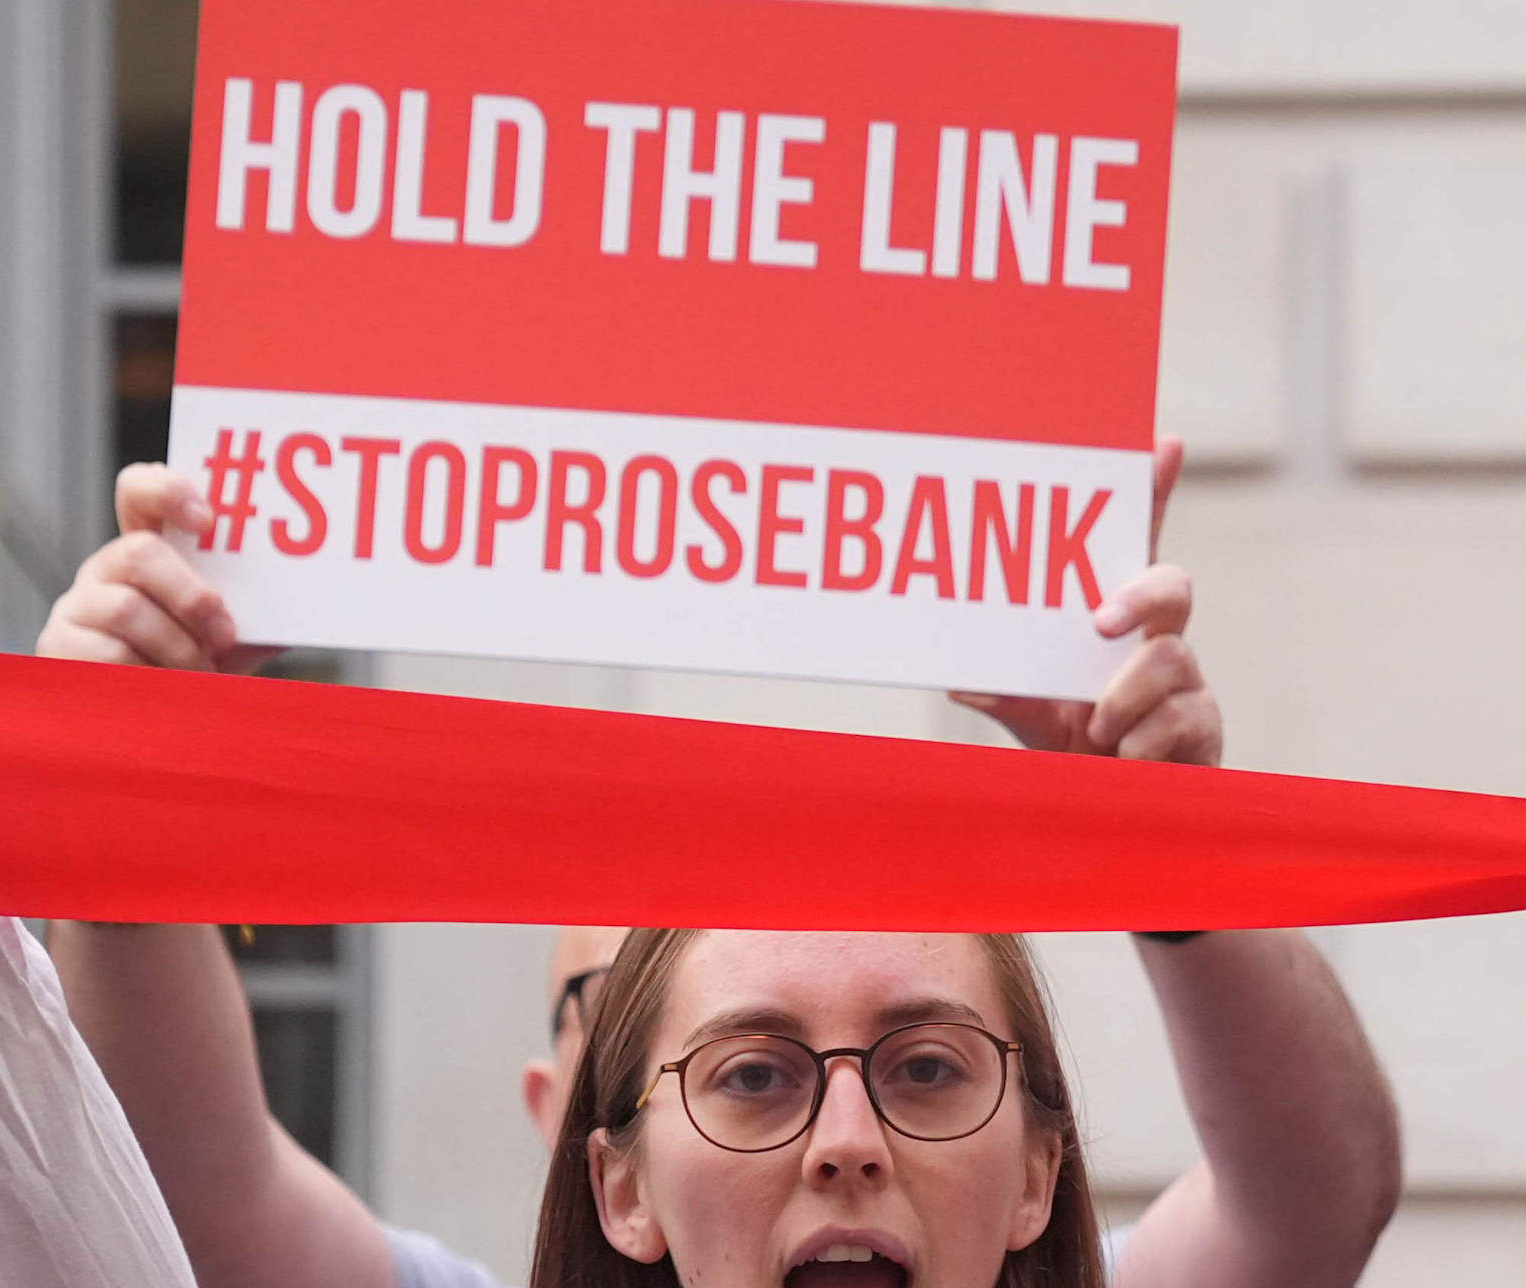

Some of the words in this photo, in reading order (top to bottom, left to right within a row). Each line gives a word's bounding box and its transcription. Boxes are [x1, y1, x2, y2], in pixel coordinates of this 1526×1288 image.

[216, 78, 547, 246] HOLD
[585, 102, 826, 268] THE
[861, 122, 1139, 291] LINE
[197, 428, 1114, 611] #STOPROSEBANK
